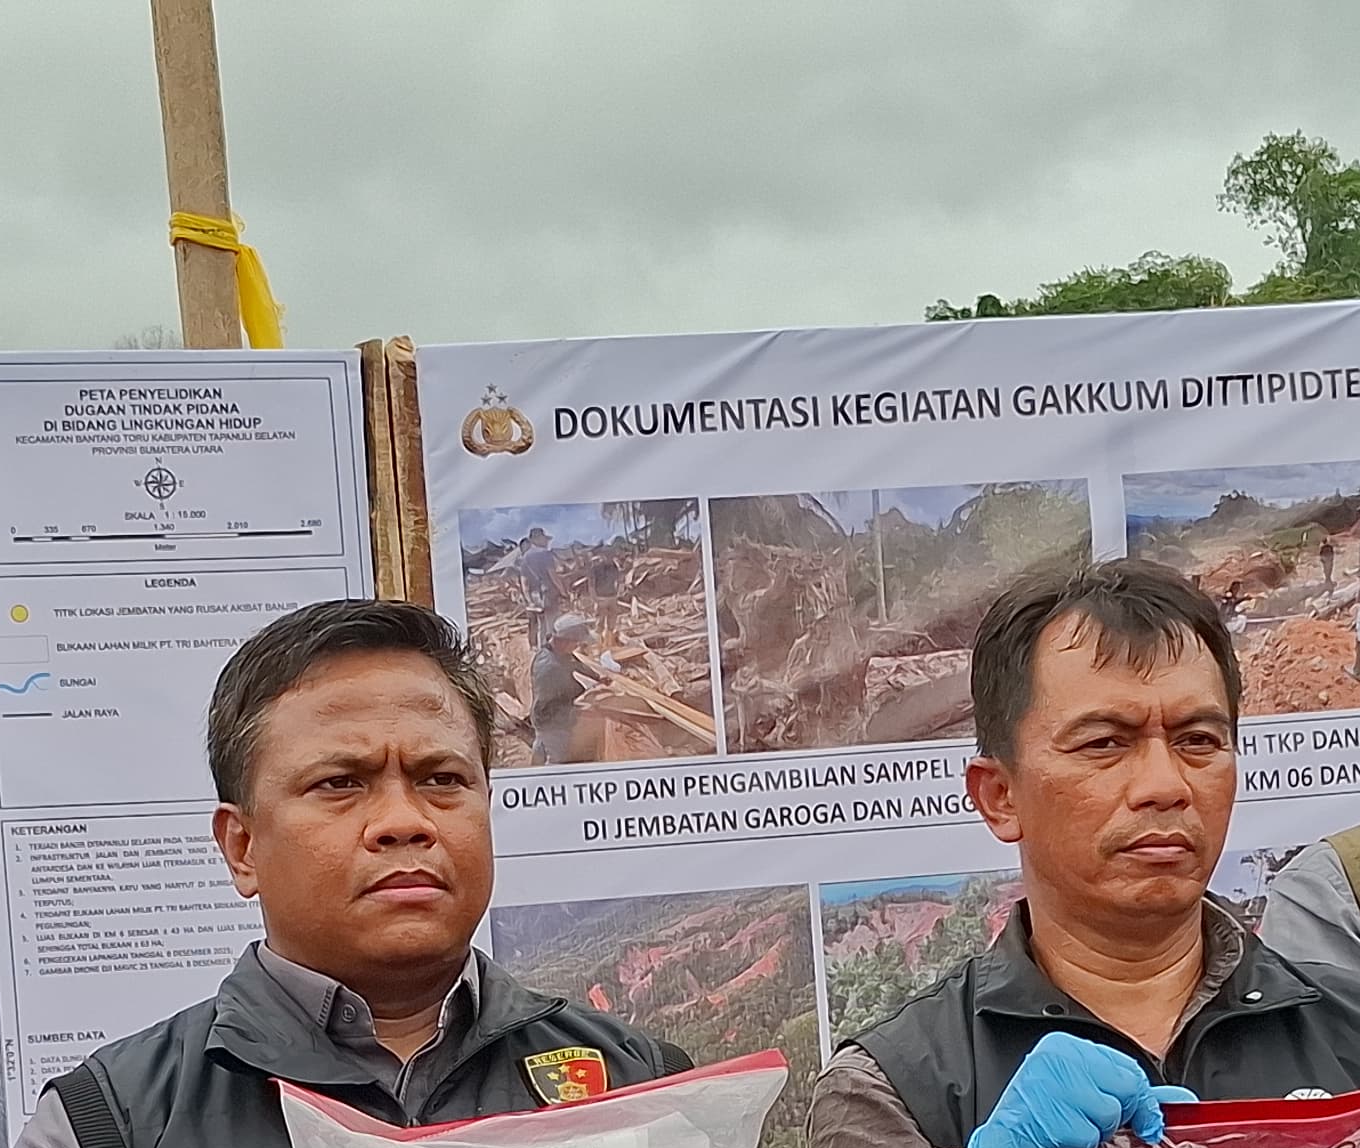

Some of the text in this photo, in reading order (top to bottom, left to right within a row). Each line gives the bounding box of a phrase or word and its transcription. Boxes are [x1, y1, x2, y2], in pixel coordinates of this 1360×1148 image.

[79, 387, 222, 401] PETA PENYELIDIKAN
[64, 402, 239, 417] DUGAAN TINDAK PIDANA
[554, 396, 820, 441] DOKUMENTASI
[832, 387, 1001, 427] KEGIATAN
[1013, 379, 1168, 416] GAKKUM
[43, 417, 262, 432] DI BIDANG LINGKUNGAN HIDUP
[15, 435, 73, 444] KECAMATAN
[151, 432, 207, 442] KABUPATEN
[208, 431, 253, 441] TAPANULI
[91, 445, 223, 455] PROVINSI SUMATERA UTARA
[124, 511, 156, 521] SKALA
[144, 578, 197, 589] LEGENDA
[53, 608, 78, 618] TITIK
[79, 607, 115, 617] LOKASI
[116, 606, 166, 616] JEMBATAN
[167, 605, 194, 615] YANG
[195, 604, 229, 614] RUSAK
[230, 603, 263, 613] AKIBAT
[56, 641, 96, 652] BUKAAN
[98, 640, 130, 651] LAHAN
[132, 639, 158, 650] MILIK
[175, 638, 191, 649] TRI
[192, 637, 238, 648] BAHTERA
[59, 677, 97, 687] SUNGAI
[62, 708, 120, 719] JALAN RAYA
[1263, 731, 1306, 754] TKP
[1312, 727, 1359, 751] DAN
[502, 785, 566, 810] OLAH
[574, 782, 618, 805] TKP
[626, 777, 676, 802] DAN
[684, 764, 855, 797] PENGAMBILAN
[862, 757, 955, 785] SAMPEL
[1244, 769, 1281, 792] KM
[1286, 766, 1314, 788] 06
[583, 818, 608, 841] DI
[613, 806, 738, 839] JEMBATAN
[744, 800, 847, 829] GAROGA
[854, 796, 903, 821] DAN
[10, 824, 88, 836] KETERANGAN
[27, 1031, 106, 1044] SUMBER DATA
